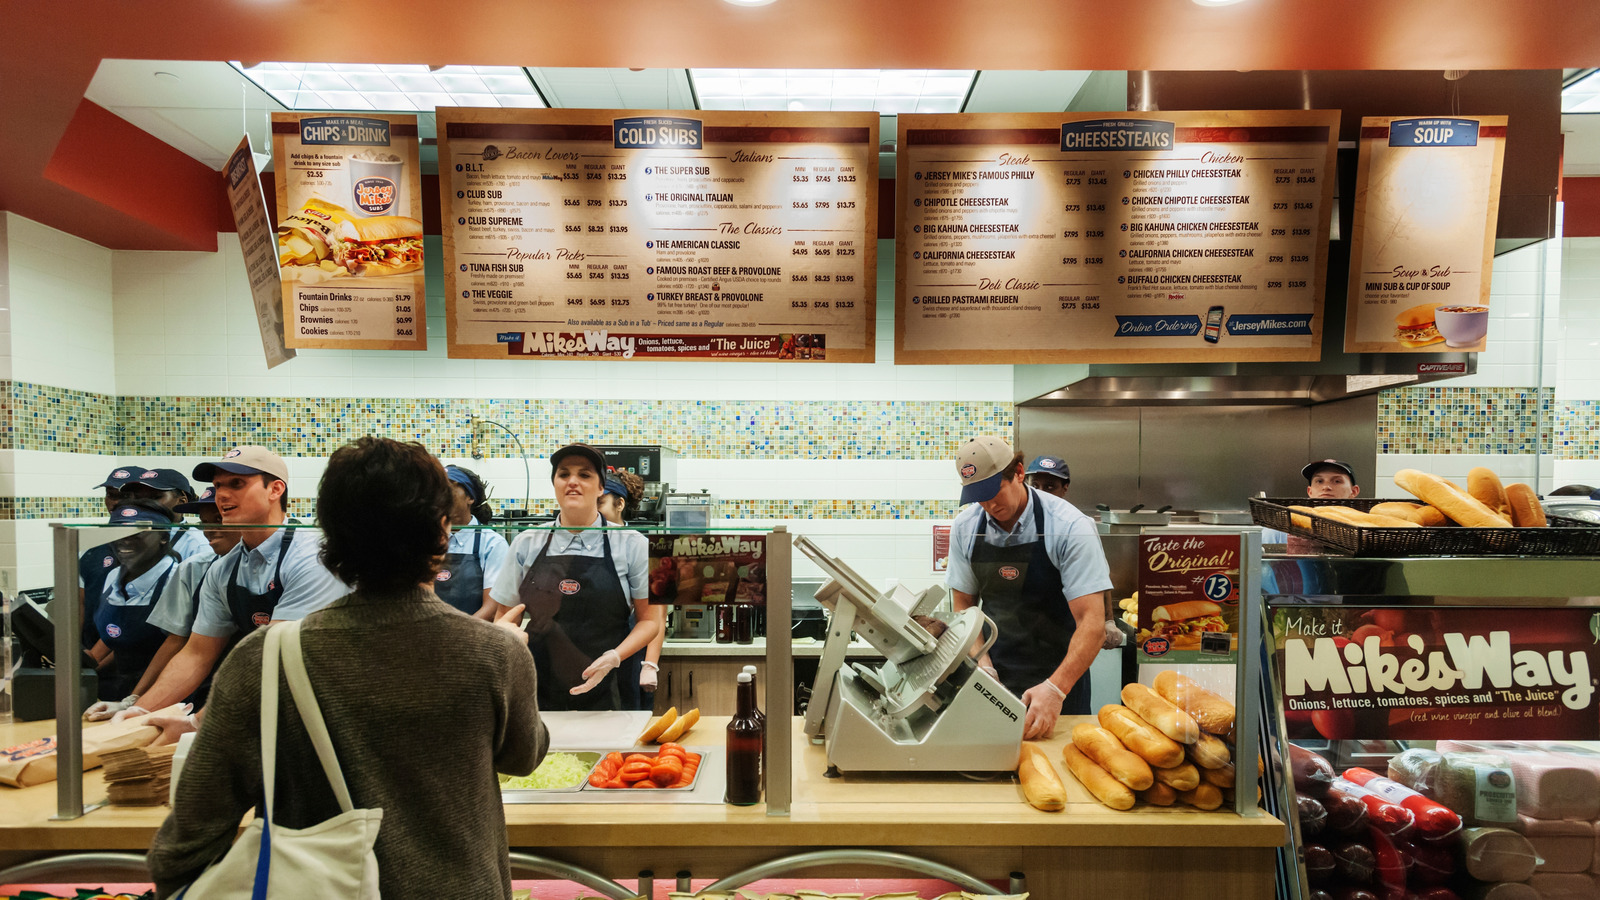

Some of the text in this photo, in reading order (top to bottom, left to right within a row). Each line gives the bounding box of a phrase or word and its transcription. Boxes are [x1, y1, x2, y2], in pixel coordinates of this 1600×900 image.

[304, 126, 340, 141] CHIPS
[349, 127, 387, 142] DRINK
[619, 127, 697, 146] COLD SUBS
[1066, 129, 1169, 148] CHEESESTEAKS
[1414, 128, 1453, 144] SOUP
[506, 146, 541, 159] Bacon
[545, 148, 579, 160] Lovers
[730, 149, 773, 163] Italians
[1201, 151, 1244, 164] Chicken
[999, 153, 1030, 166] Steak
[924, 171, 1035, 180] JERSEY MIKE'S FAMOUS PHILLY
[1133, 169, 1241, 178] CHICKEN PHILLY CHEESESTEAK
[357, 183, 392, 197] Jersey
[467, 190, 502, 199] CLUB SUB
[655, 193, 733, 202] THE ORIGINAL ITALIAN
[924, 198, 1009, 207] CHIPOTLE CHEESESTEAK
[719, 222, 782, 235] The Classics
[656, 241, 740, 249] THE AMERICAN CLASSIC
[506, 248, 585, 262] Popular Picks
[470, 264, 490, 272] TUNA
[492, 264, 507, 272] FISH
[656, 267, 781, 276] FAMOUS ROAST BEEF & PROVOLONE
[1393, 265, 1419, 279] Soup
[1430, 265, 1451, 278] Sub
[979, 278, 1040, 291] Deli Classic
[1128, 275, 1241, 284] BUFFALO CHICKEN CHEESESTEAK
[1365, 282, 1451, 291] MINI SUB & CUP OF SOUP
[299, 292, 352, 301] Fountain Drinks
[472, 290, 513, 299] THE VEGGIE
[657, 293, 684, 301] TURKEY
[685, 293, 713, 301] BREAST
[722, 293, 763, 302] PROVOLONE
[922, 296, 1018, 304] GRILLED PASTRAMI REUBEN
[300, 304, 319, 313] Chips
[300, 315, 333, 324] Brownies
[301, 327, 328, 335] Cookies
[1121, 320, 1198, 334] Online Ordering
[1232, 320, 1306, 332] JerseyMikes.com
[638, 338, 685, 346] Onions, lettuce,
[678, 344, 697, 352] spices
[710, 337, 776, 350] "The Juice"
[1419, 363, 1463, 371] CAPTIVEAIRE
[1144, 537, 1206, 552] Taste the
[1148, 550, 1234, 574] Original!
[1285, 617, 1342, 636] Make it
[974, 682, 1018, 722] BIZERBA
[1289, 689, 1560, 711] Onions, lettuce, tomatoes, spices and "The Juice"
[1410, 710, 1428, 723] (red
[1431, 711, 1450, 721] wine
[1453, 710, 1481, 724] vinegar
[1485, 708, 1499, 720] and
[1502, 708, 1521, 720] olive
[1524, 707, 1534, 718] oil
